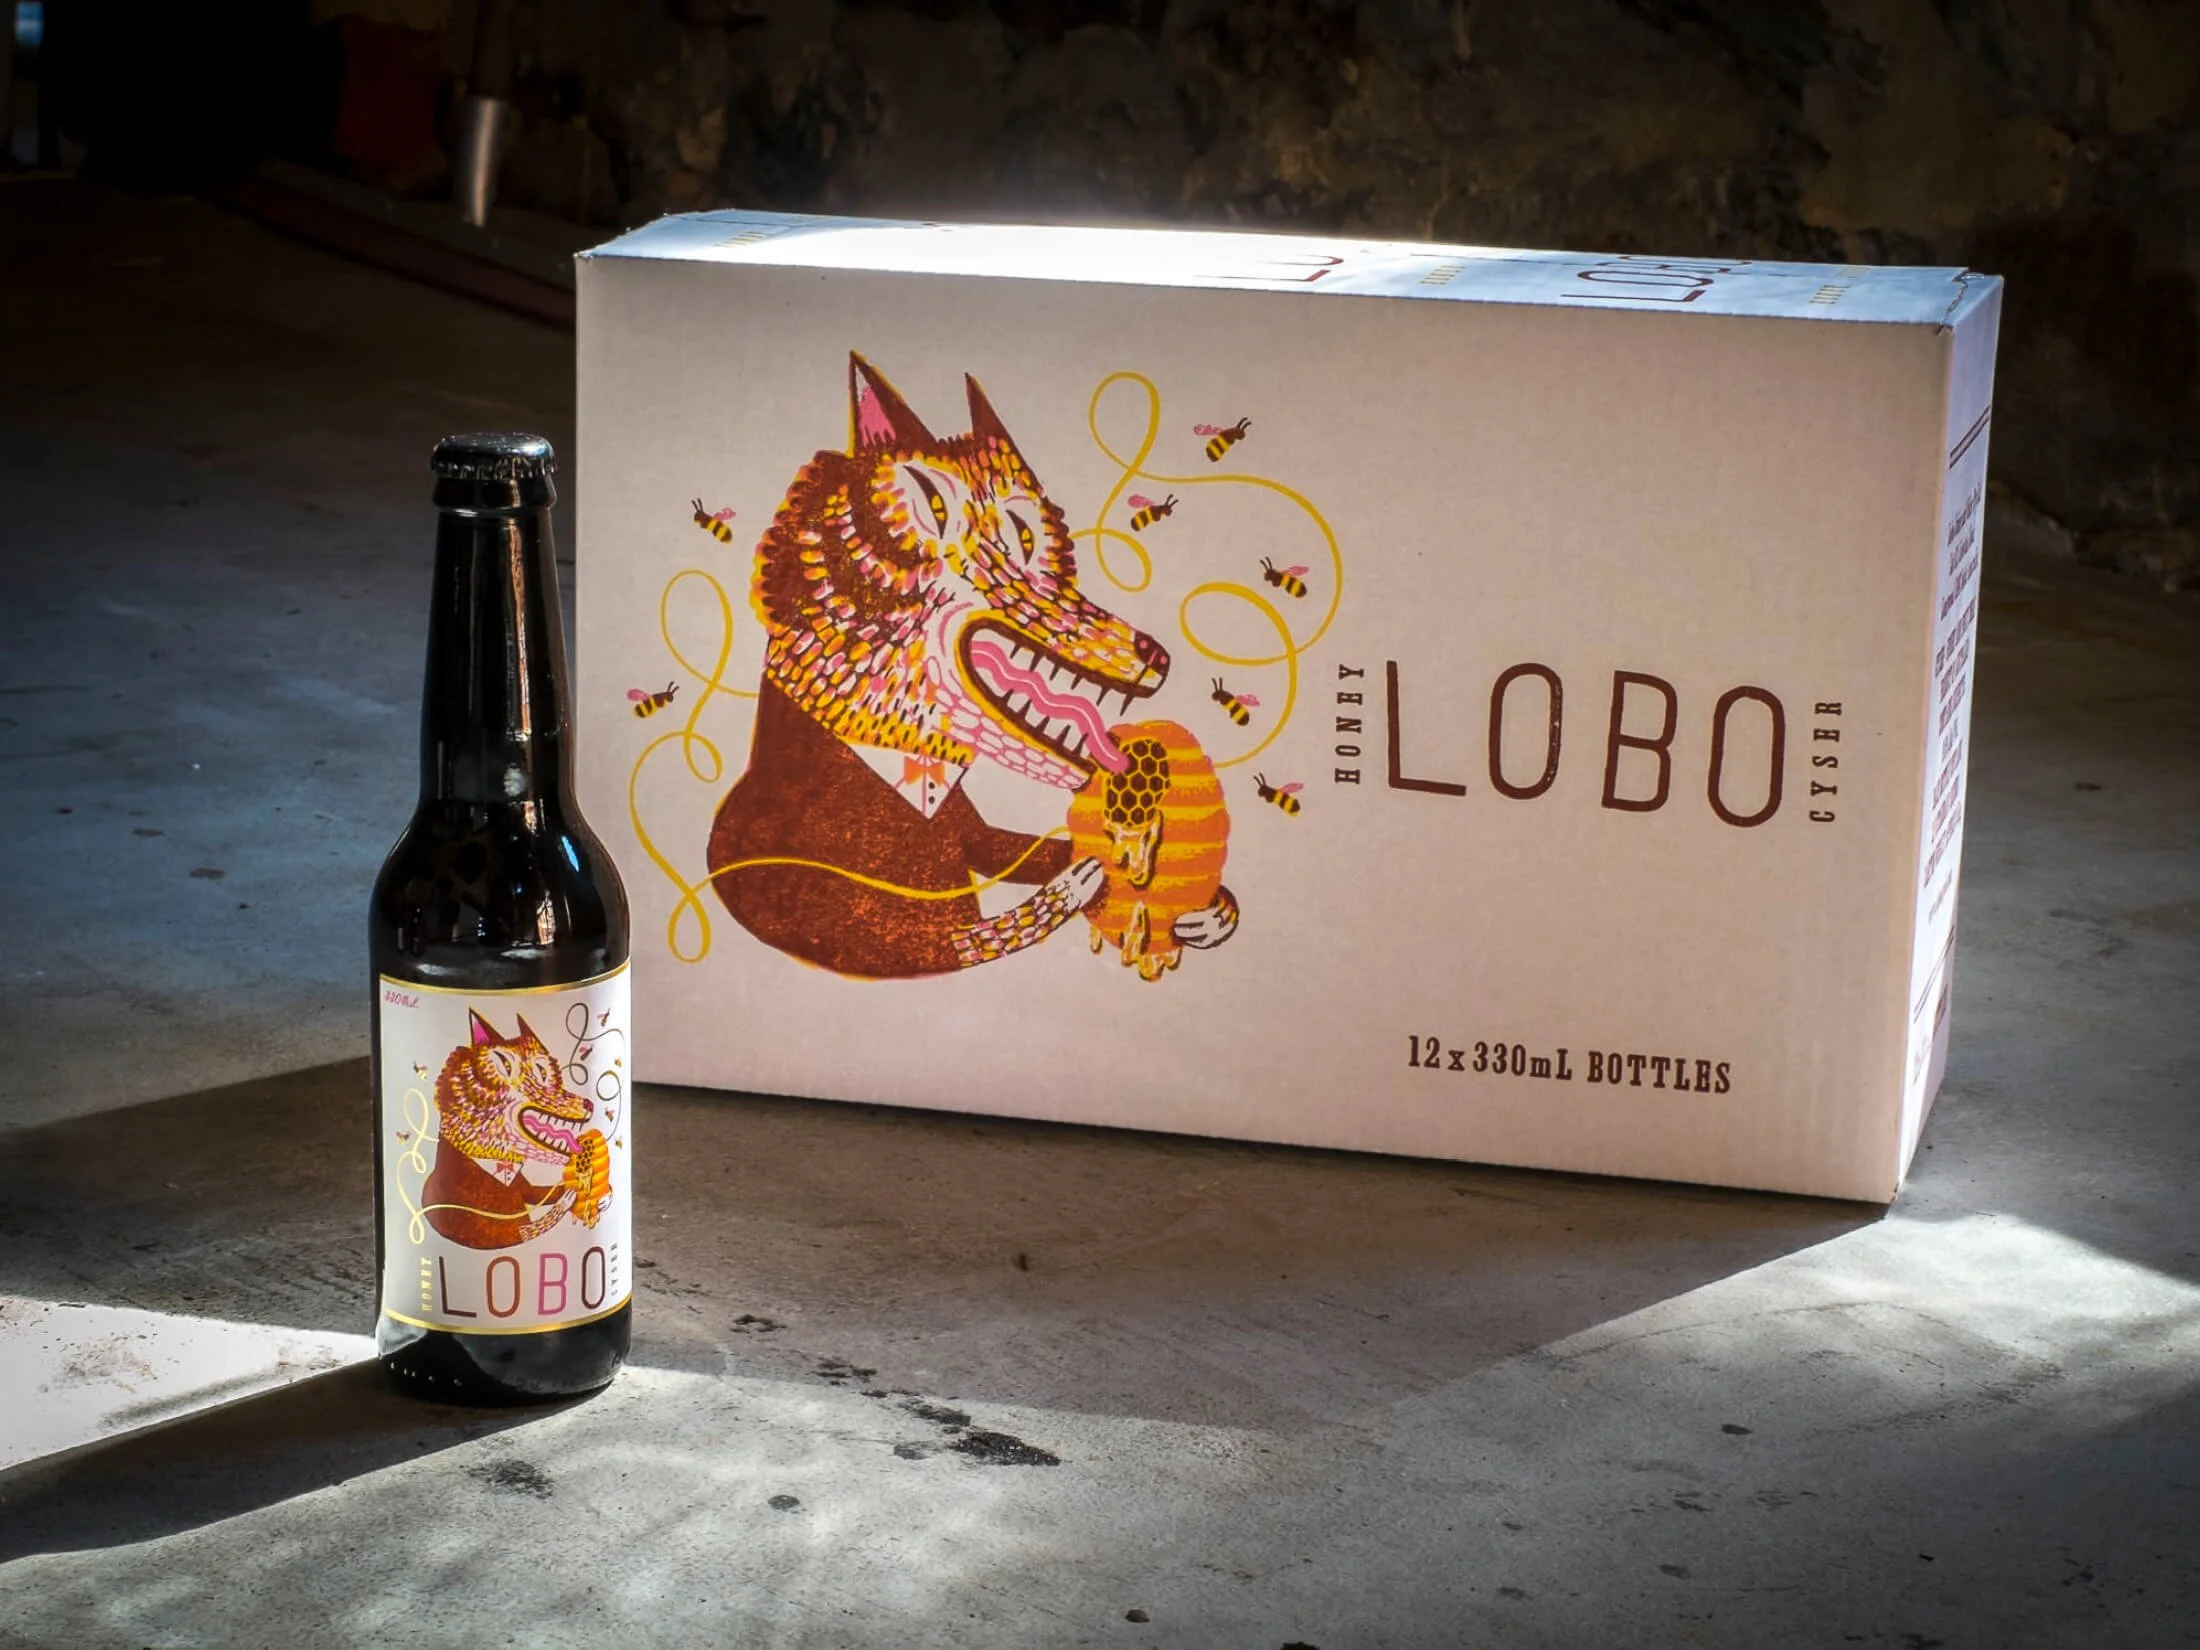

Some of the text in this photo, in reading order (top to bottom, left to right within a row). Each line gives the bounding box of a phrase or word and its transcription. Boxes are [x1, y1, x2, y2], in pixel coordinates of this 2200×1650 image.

[1335, 664, 1364, 784] HONEY
[1386, 660, 1786, 828] LOBO
[1809, 701, 1842, 823] CYSER
[1587, 1050, 1731, 1095] BOTTLES
[438, 1246, 606, 1319] LOBO
